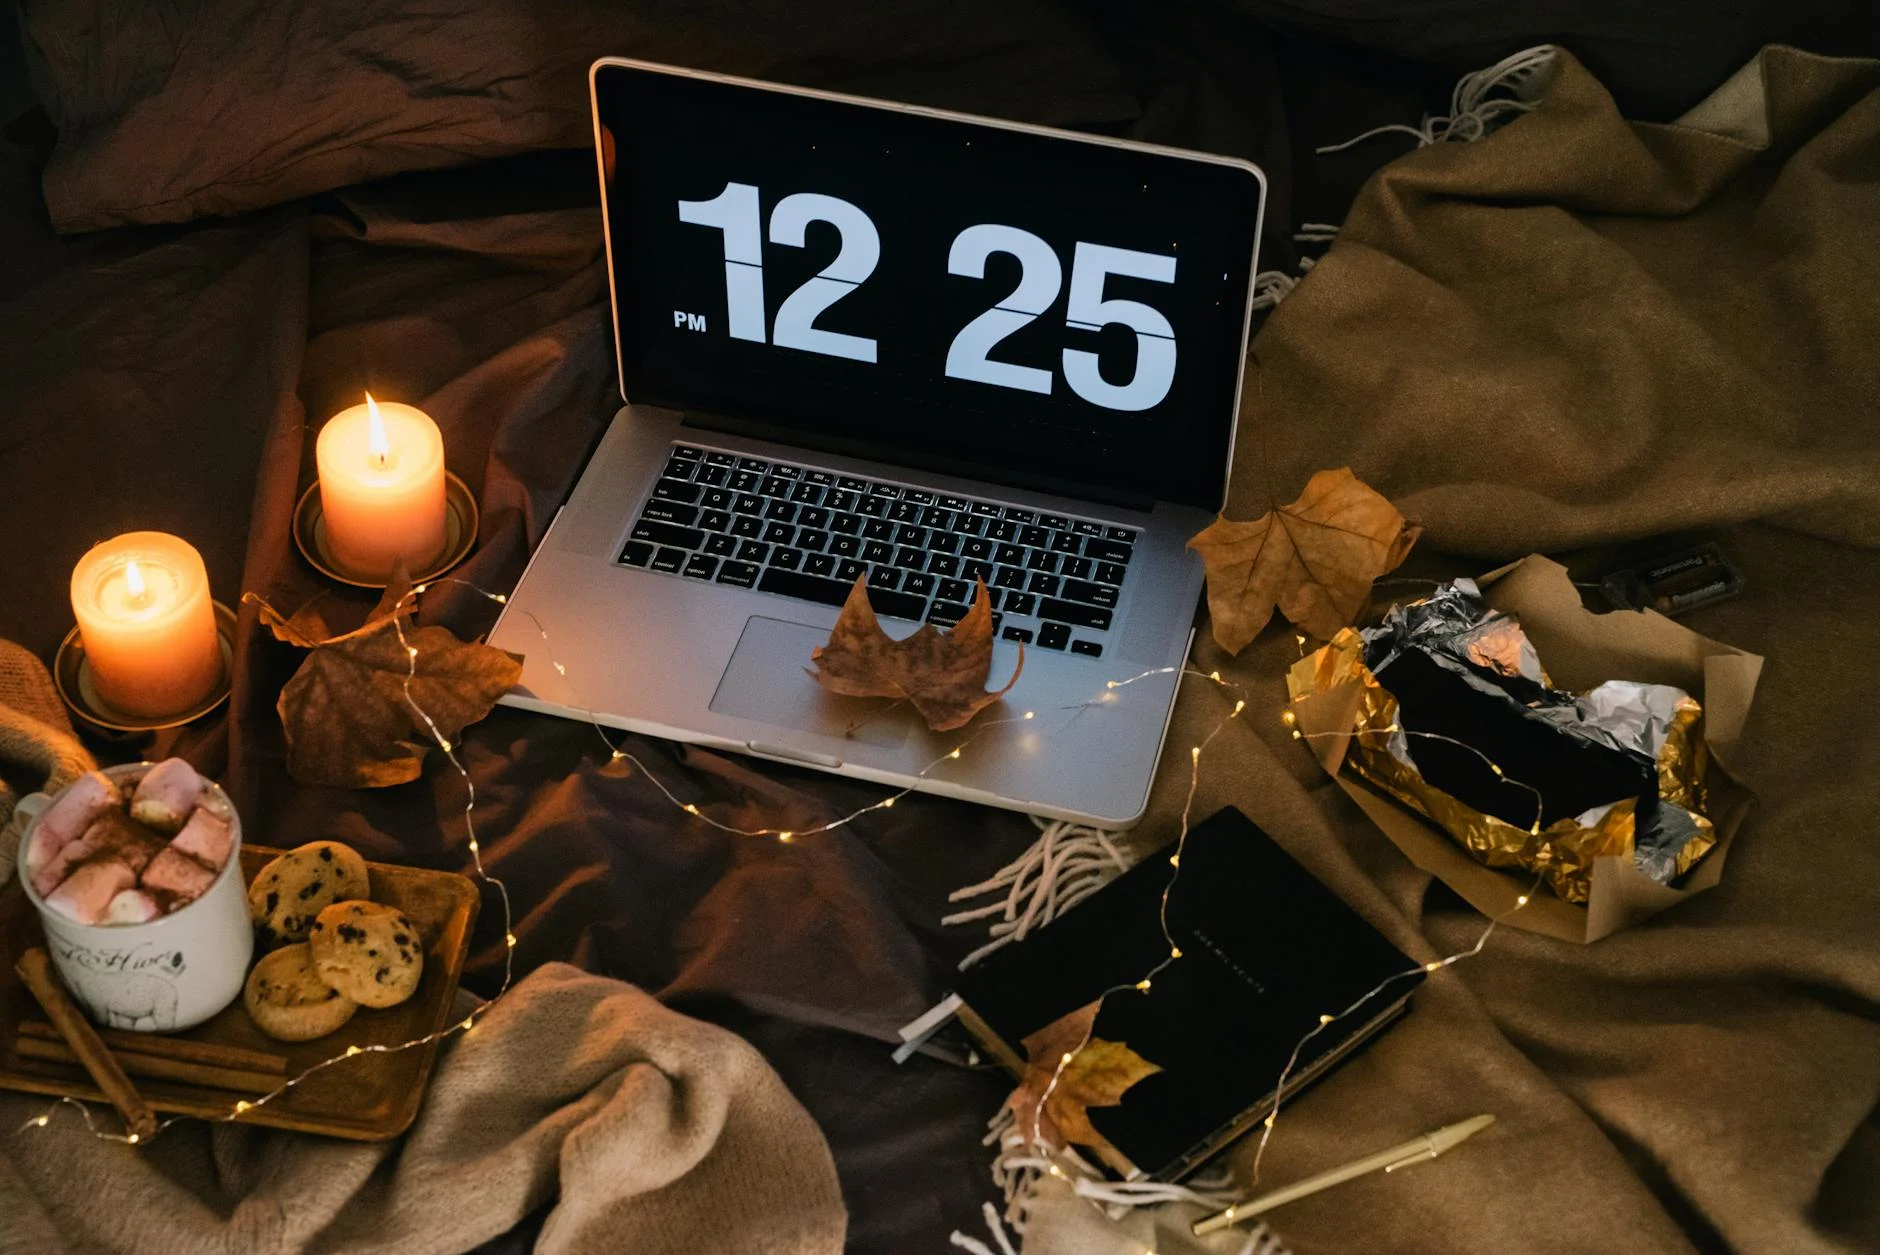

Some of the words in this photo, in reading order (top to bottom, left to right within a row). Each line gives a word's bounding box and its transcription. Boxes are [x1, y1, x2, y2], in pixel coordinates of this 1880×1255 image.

[679, 182, 880, 363] 12
[945, 224, 1176, 411] 25
[674, 311, 706, 332] PM
[712, 494, 721, 502] Q
[743, 499, 754, 508] W
[777, 506, 784, 514] E
[709, 516, 718, 524] A
[809, 512, 817, 520] R
[743, 522, 750, 530] S
[843, 518, 849, 526] T
[775, 528, 783, 536] D
[907, 531, 916, 539] U
[716, 540, 725, 548] Z
[839, 541, 849, 549] G
[972, 543, 981, 552] O
[748, 546, 757, 555] X
[872, 547, 882, 555] H
[781, 553, 790, 561] C
[907, 554, 914, 562] J
[815, 559, 824, 567] V
[939, 560, 948, 568] K
[847, 566, 855, 574] B
[973, 567, 979, 575] L
[880, 572, 890, 580] N
[912, 579, 923, 587] M
